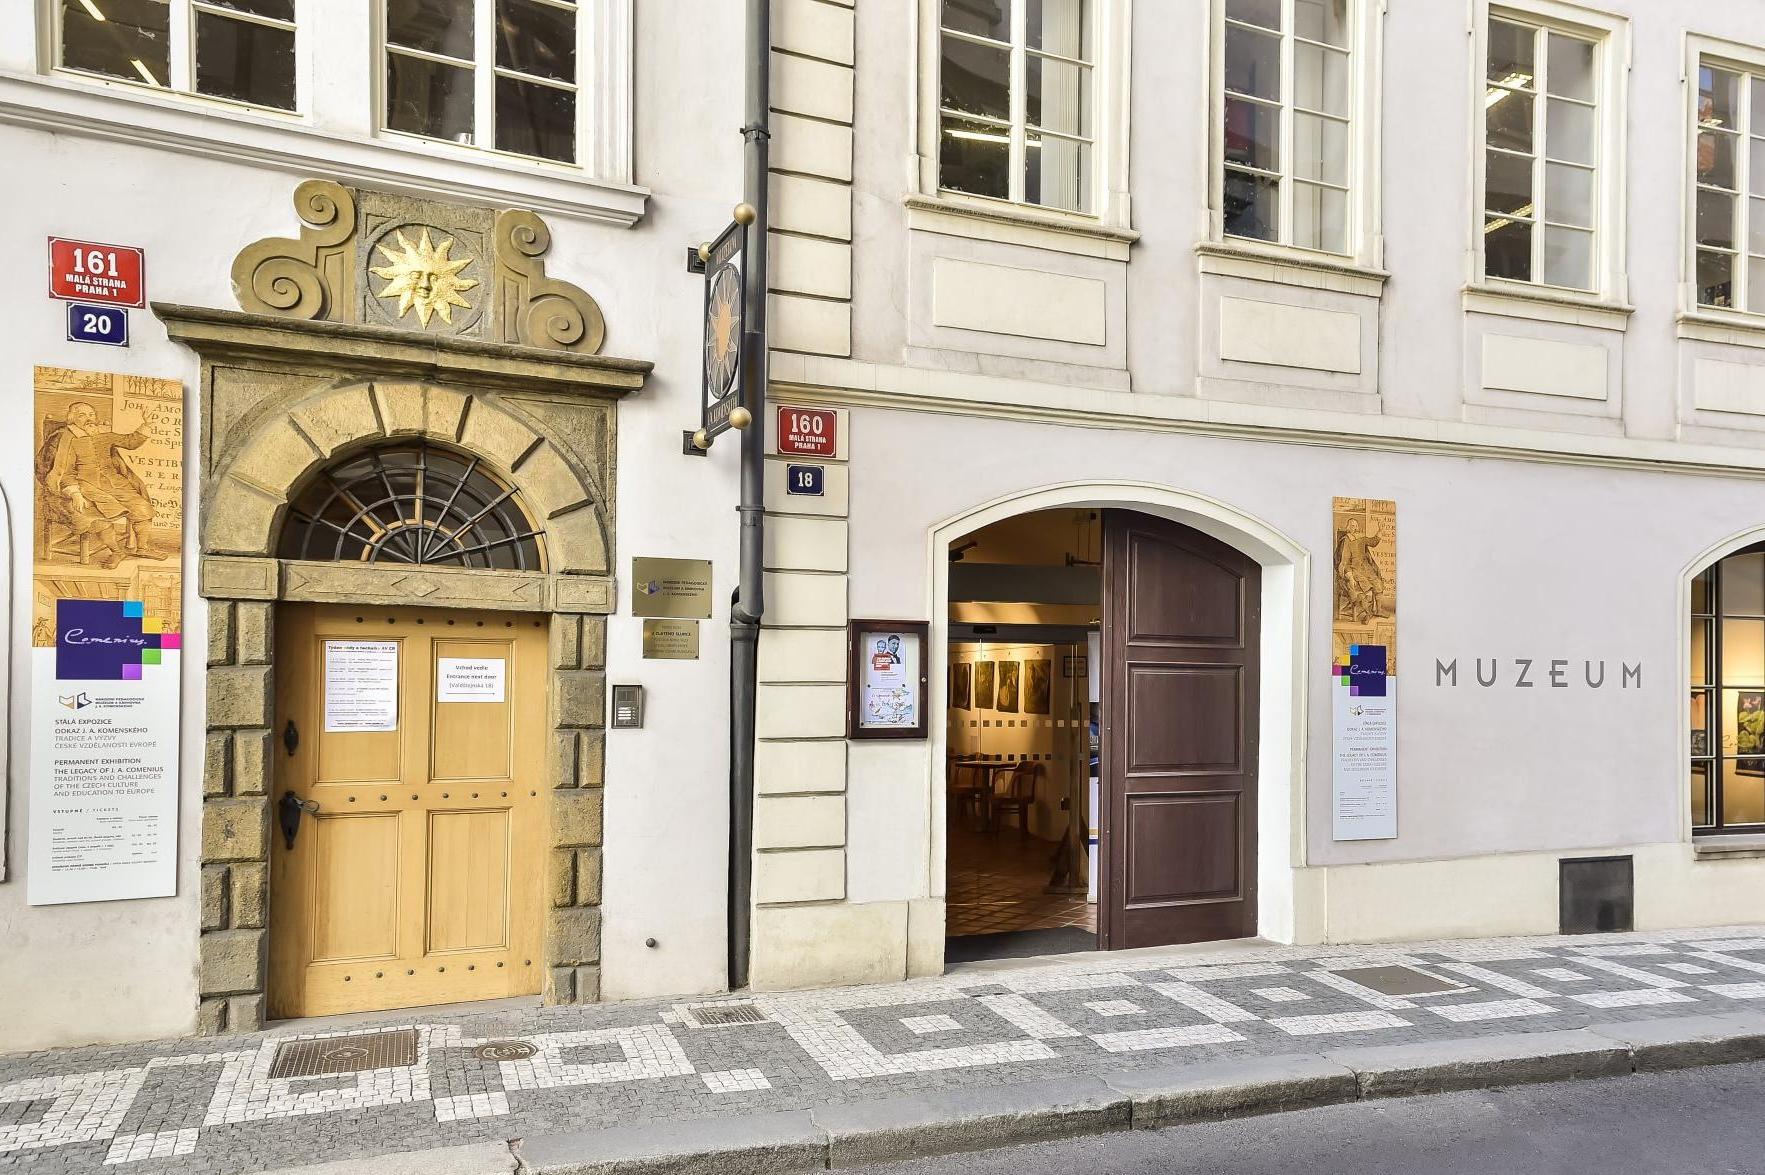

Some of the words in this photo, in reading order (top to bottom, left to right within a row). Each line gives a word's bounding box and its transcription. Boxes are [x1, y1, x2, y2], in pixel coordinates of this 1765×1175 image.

[73, 248, 119, 277] 161
[66, 273, 91, 286] MALÁ
[92, 277, 126, 289] STRANA
[75, 284, 109, 296] PRAHA
[112, 288, 118, 297] 1
[83, 314, 111, 335] 20
[791, 414, 823, 434] 160
[788, 434, 804, 442] MALÁ
[806, 436, 827, 444] STRANA
[794, 442, 816, 450] PRAHA
[798, 472, 813, 488] 18
[1436, 657, 1642, 689] MUZEUM
